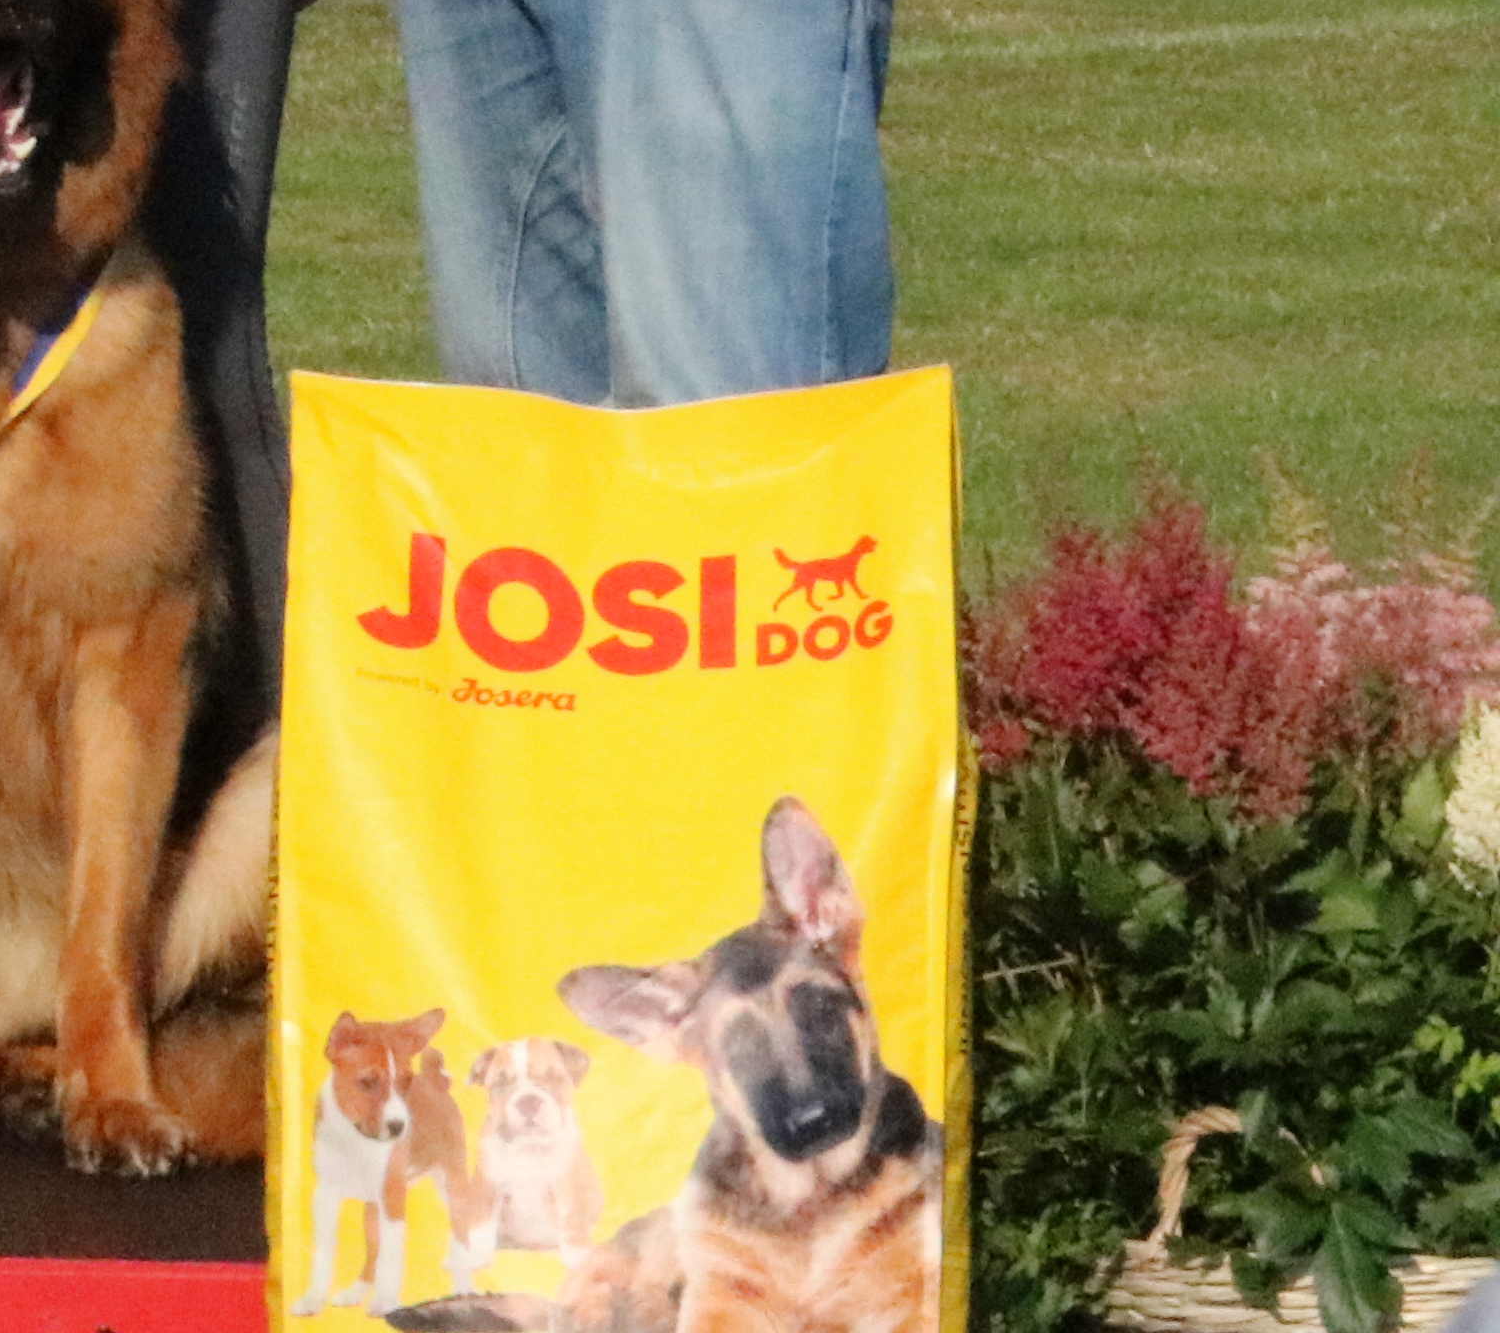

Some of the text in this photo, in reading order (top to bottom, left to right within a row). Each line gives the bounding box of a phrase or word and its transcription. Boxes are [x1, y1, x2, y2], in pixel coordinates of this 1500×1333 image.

[356, 531, 894, 677] JOSI DOG
[451, 677, 577, 712] Josera
